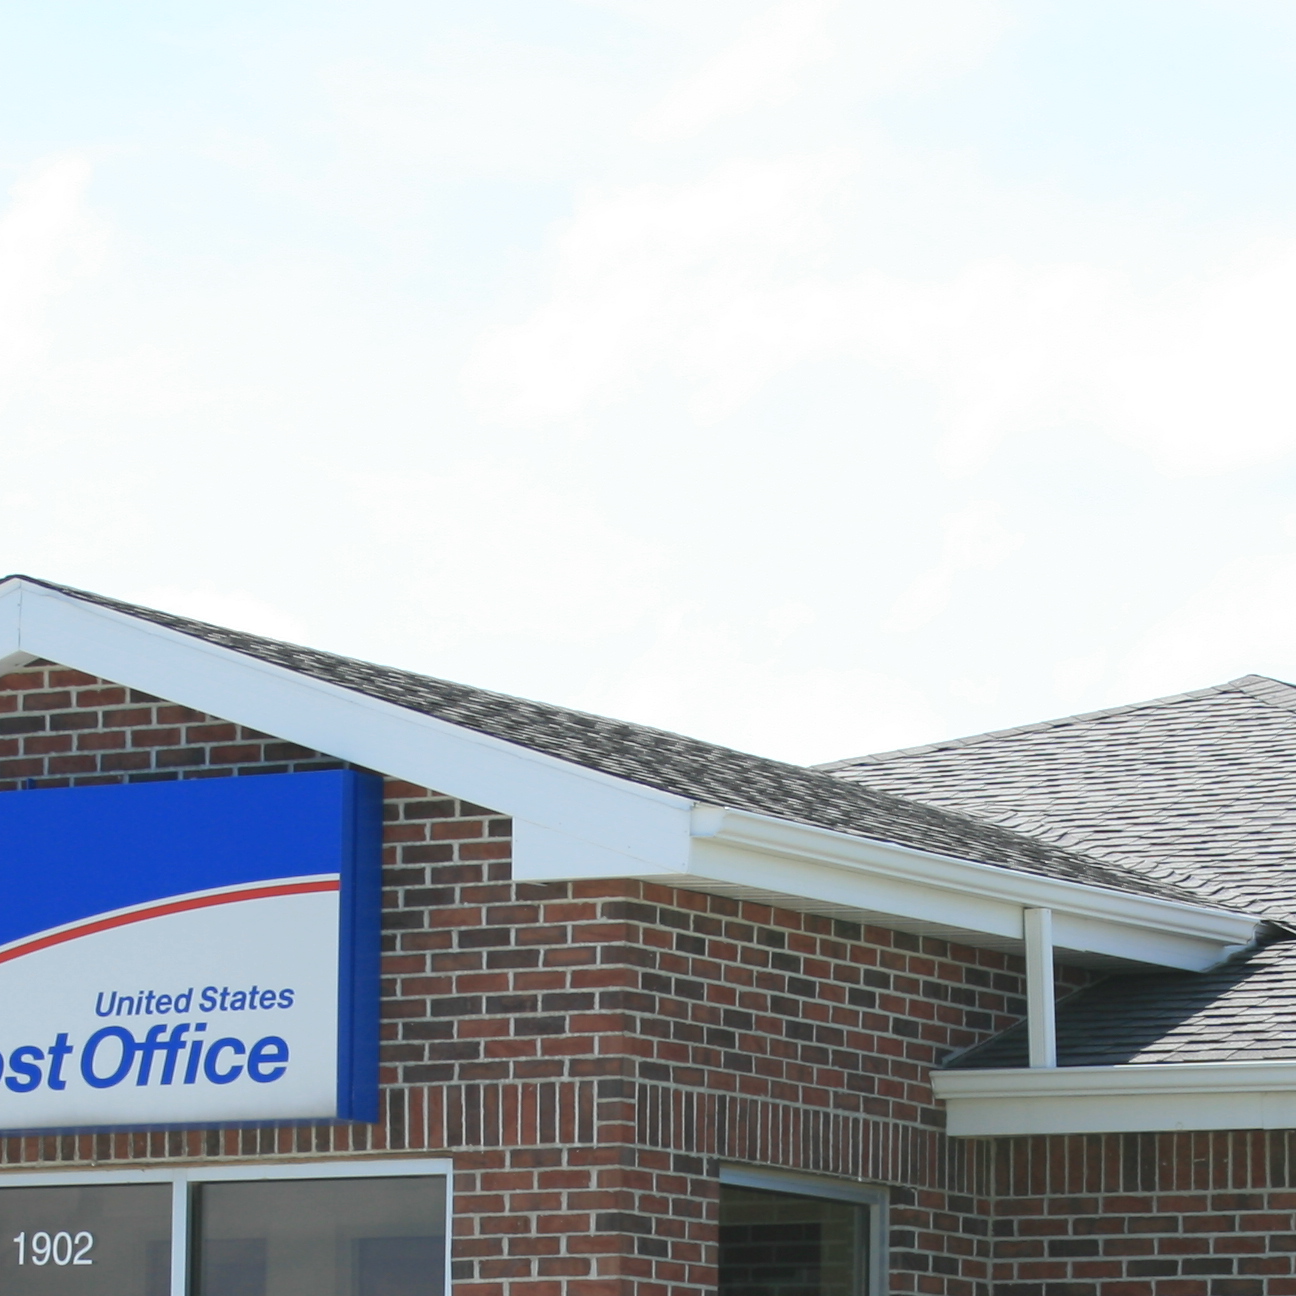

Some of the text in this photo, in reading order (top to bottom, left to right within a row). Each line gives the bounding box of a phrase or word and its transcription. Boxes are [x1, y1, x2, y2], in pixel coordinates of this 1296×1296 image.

[95, 985, 295, 1017] United States
[80, 1022, 289, 1089] Office
[13, 1231, 94, 1266] 1902
